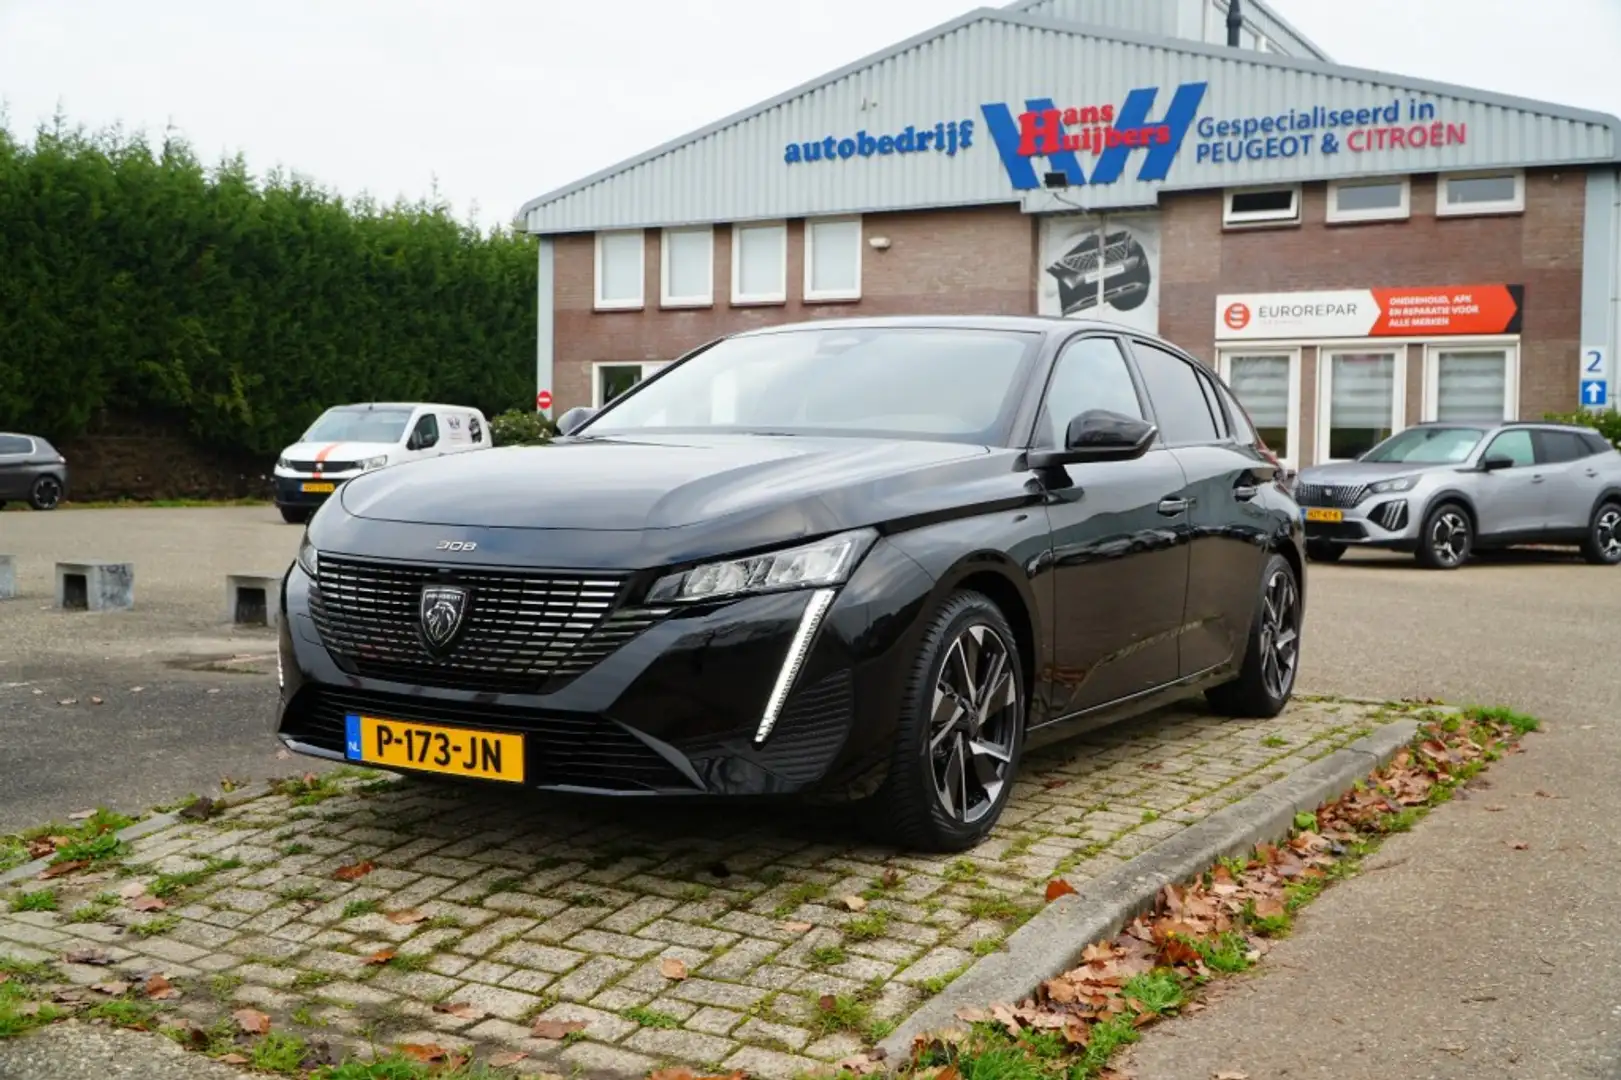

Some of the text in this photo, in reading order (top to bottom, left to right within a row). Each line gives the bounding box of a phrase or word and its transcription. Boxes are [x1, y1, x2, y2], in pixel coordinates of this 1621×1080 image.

[1197, 98, 1434, 139] Gespecialiseerd in
[784, 120, 974, 164] autobedrijf
[1196, 122, 1467, 163] PEUGEOT & CITROËN
[1258, 303, 1357, 318] EUROREPAR
[1451, 304, 1479, 314] VOOR
[1388, 316, 1449, 328] ALLE MERKEN
[1587, 350, 1602, 373] 2
[436, 540, 477, 552] 308
[348, 725, 502, 773] NL P-173-JN
